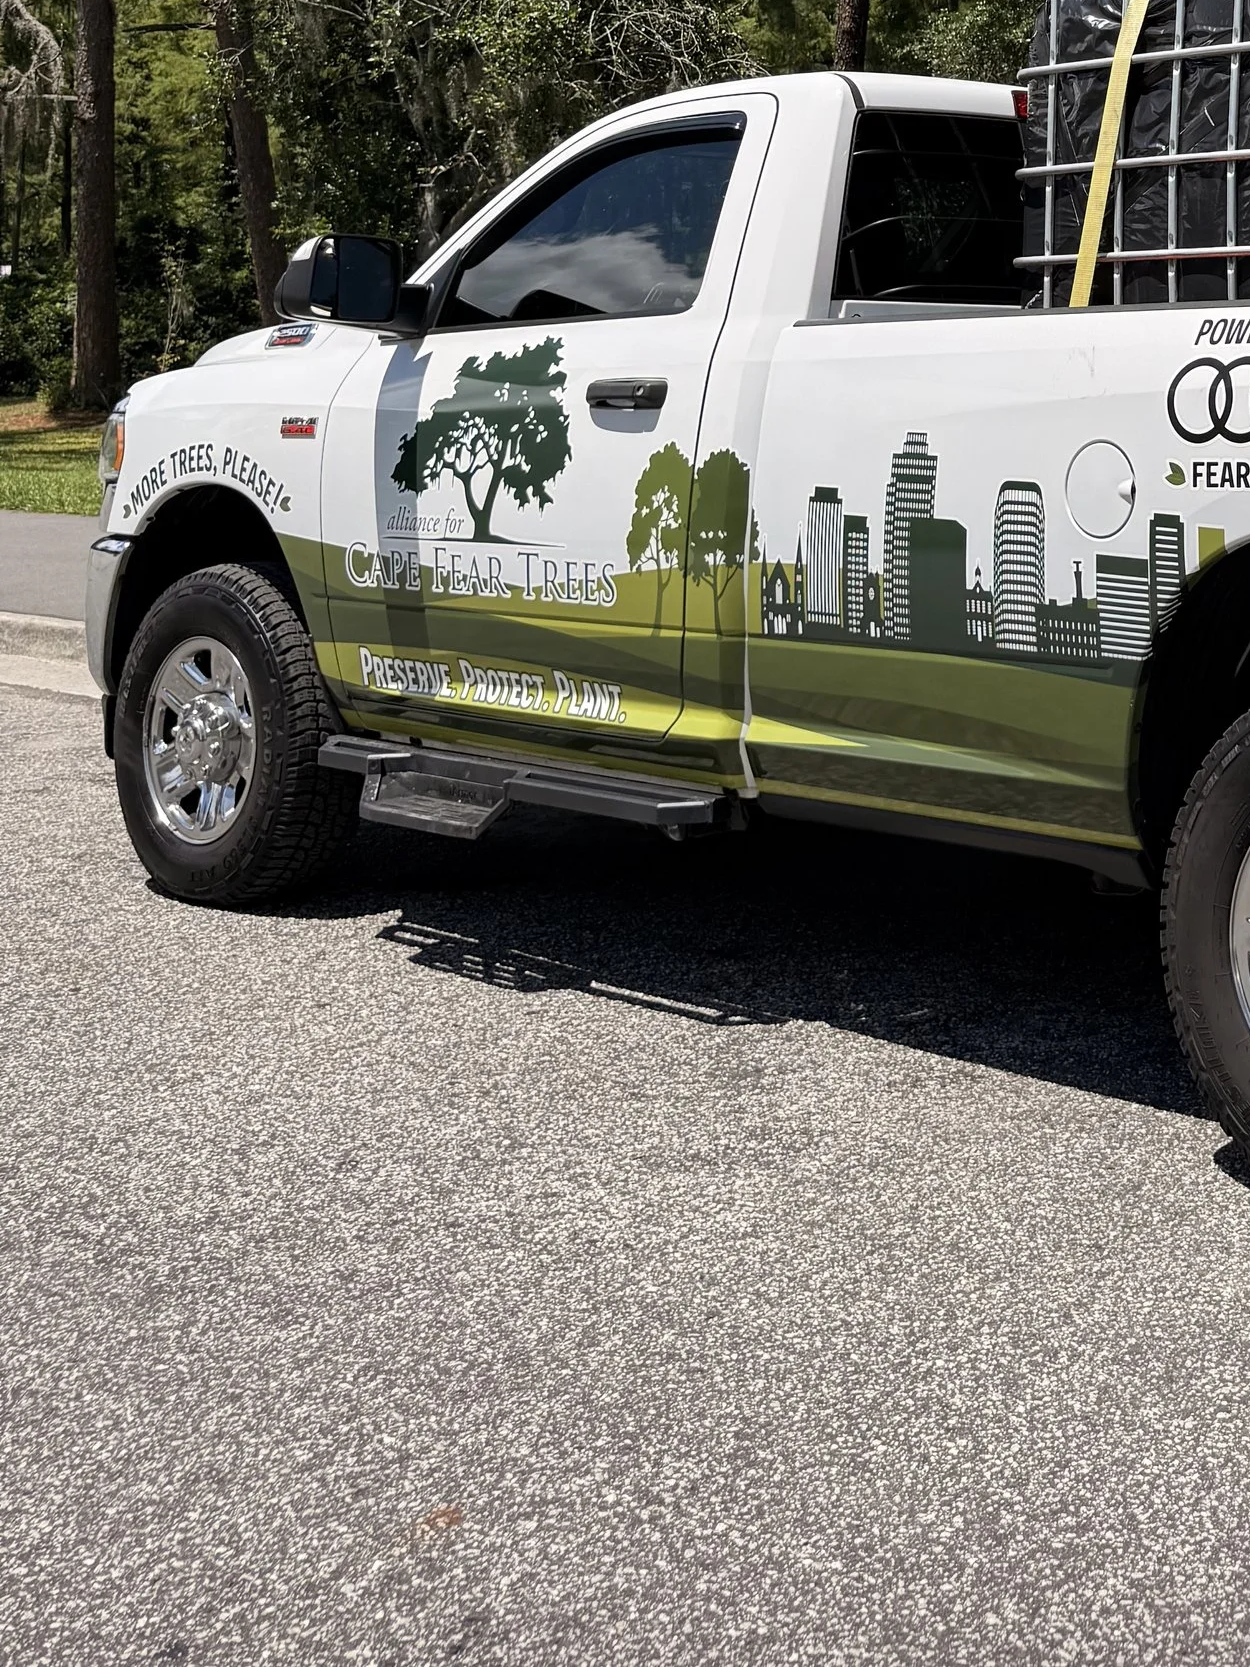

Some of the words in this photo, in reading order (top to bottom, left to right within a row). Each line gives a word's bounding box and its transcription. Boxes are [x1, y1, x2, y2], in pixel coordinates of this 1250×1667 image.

[130, 458, 168, 516] MORE
[170, 443, 218, 478] TREES,
[222, 446, 284, 514] PLEASE!
[386, 506, 441, 534] alliance
[443, 507, 465, 540] for
[347, 541, 421, 589] CAPE
[432, 546, 511, 598] FEAR
[517, 551, 616, 606] TREES
[358, 645, 457, 699] PRESERVE.
[457, 657, 549, 712] PROTECT.
[552, 668, 627, 724] PLANT.
